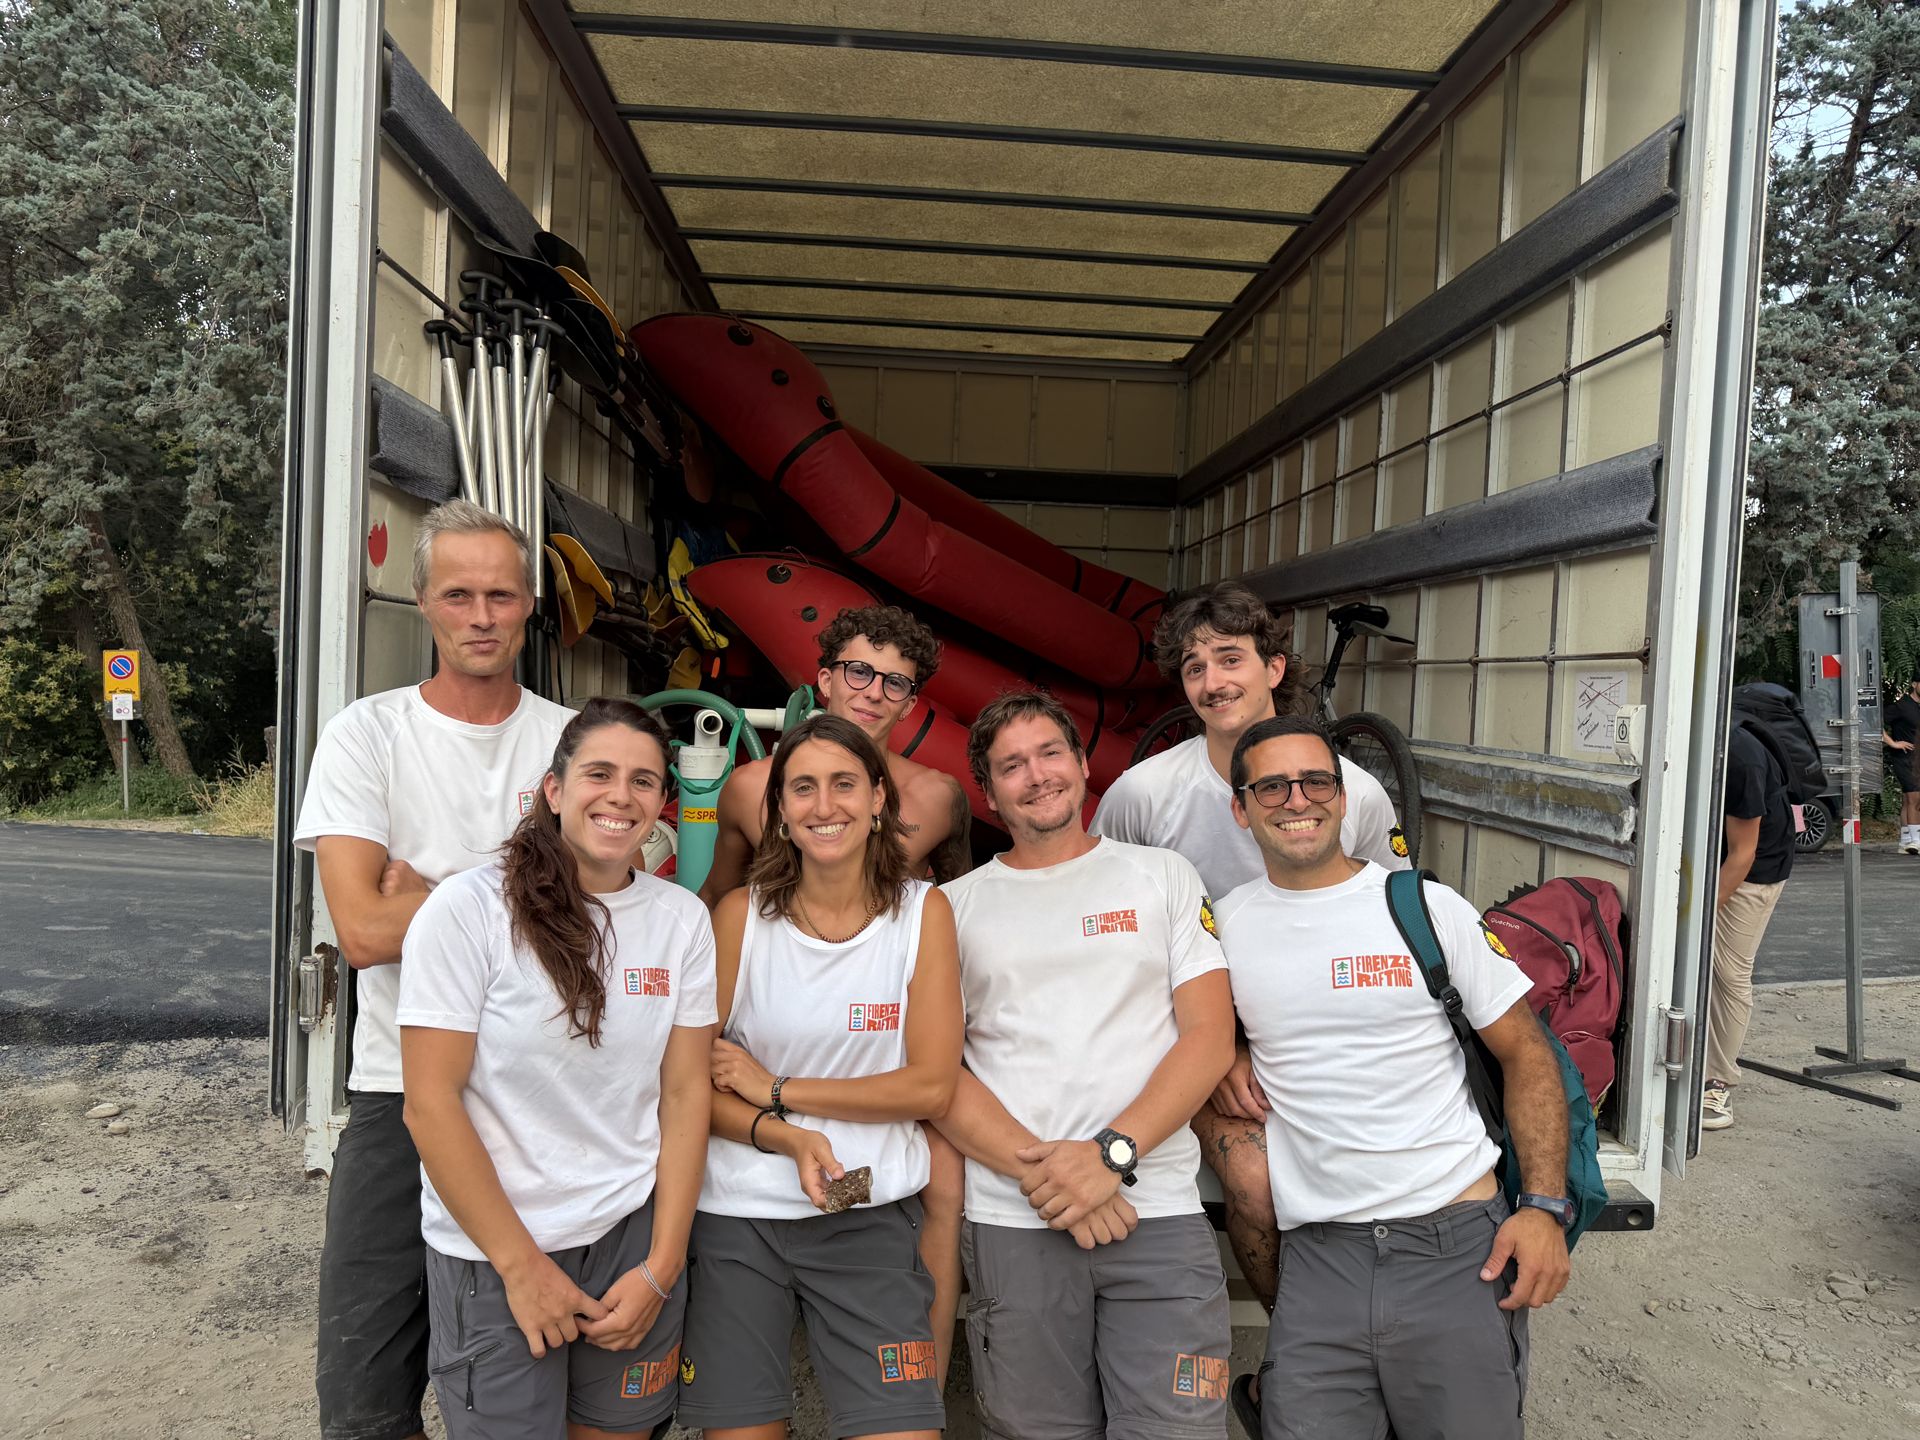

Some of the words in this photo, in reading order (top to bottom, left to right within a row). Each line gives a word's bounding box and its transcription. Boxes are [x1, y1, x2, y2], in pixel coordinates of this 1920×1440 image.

[1099, 909, 1137, 924] FIRENZE
[1100, 919, 1138, 934] RAFTING
[1355, 954, 1412, 973] FIRENZE
[1356, 969, 1413, 987] RAFTING
